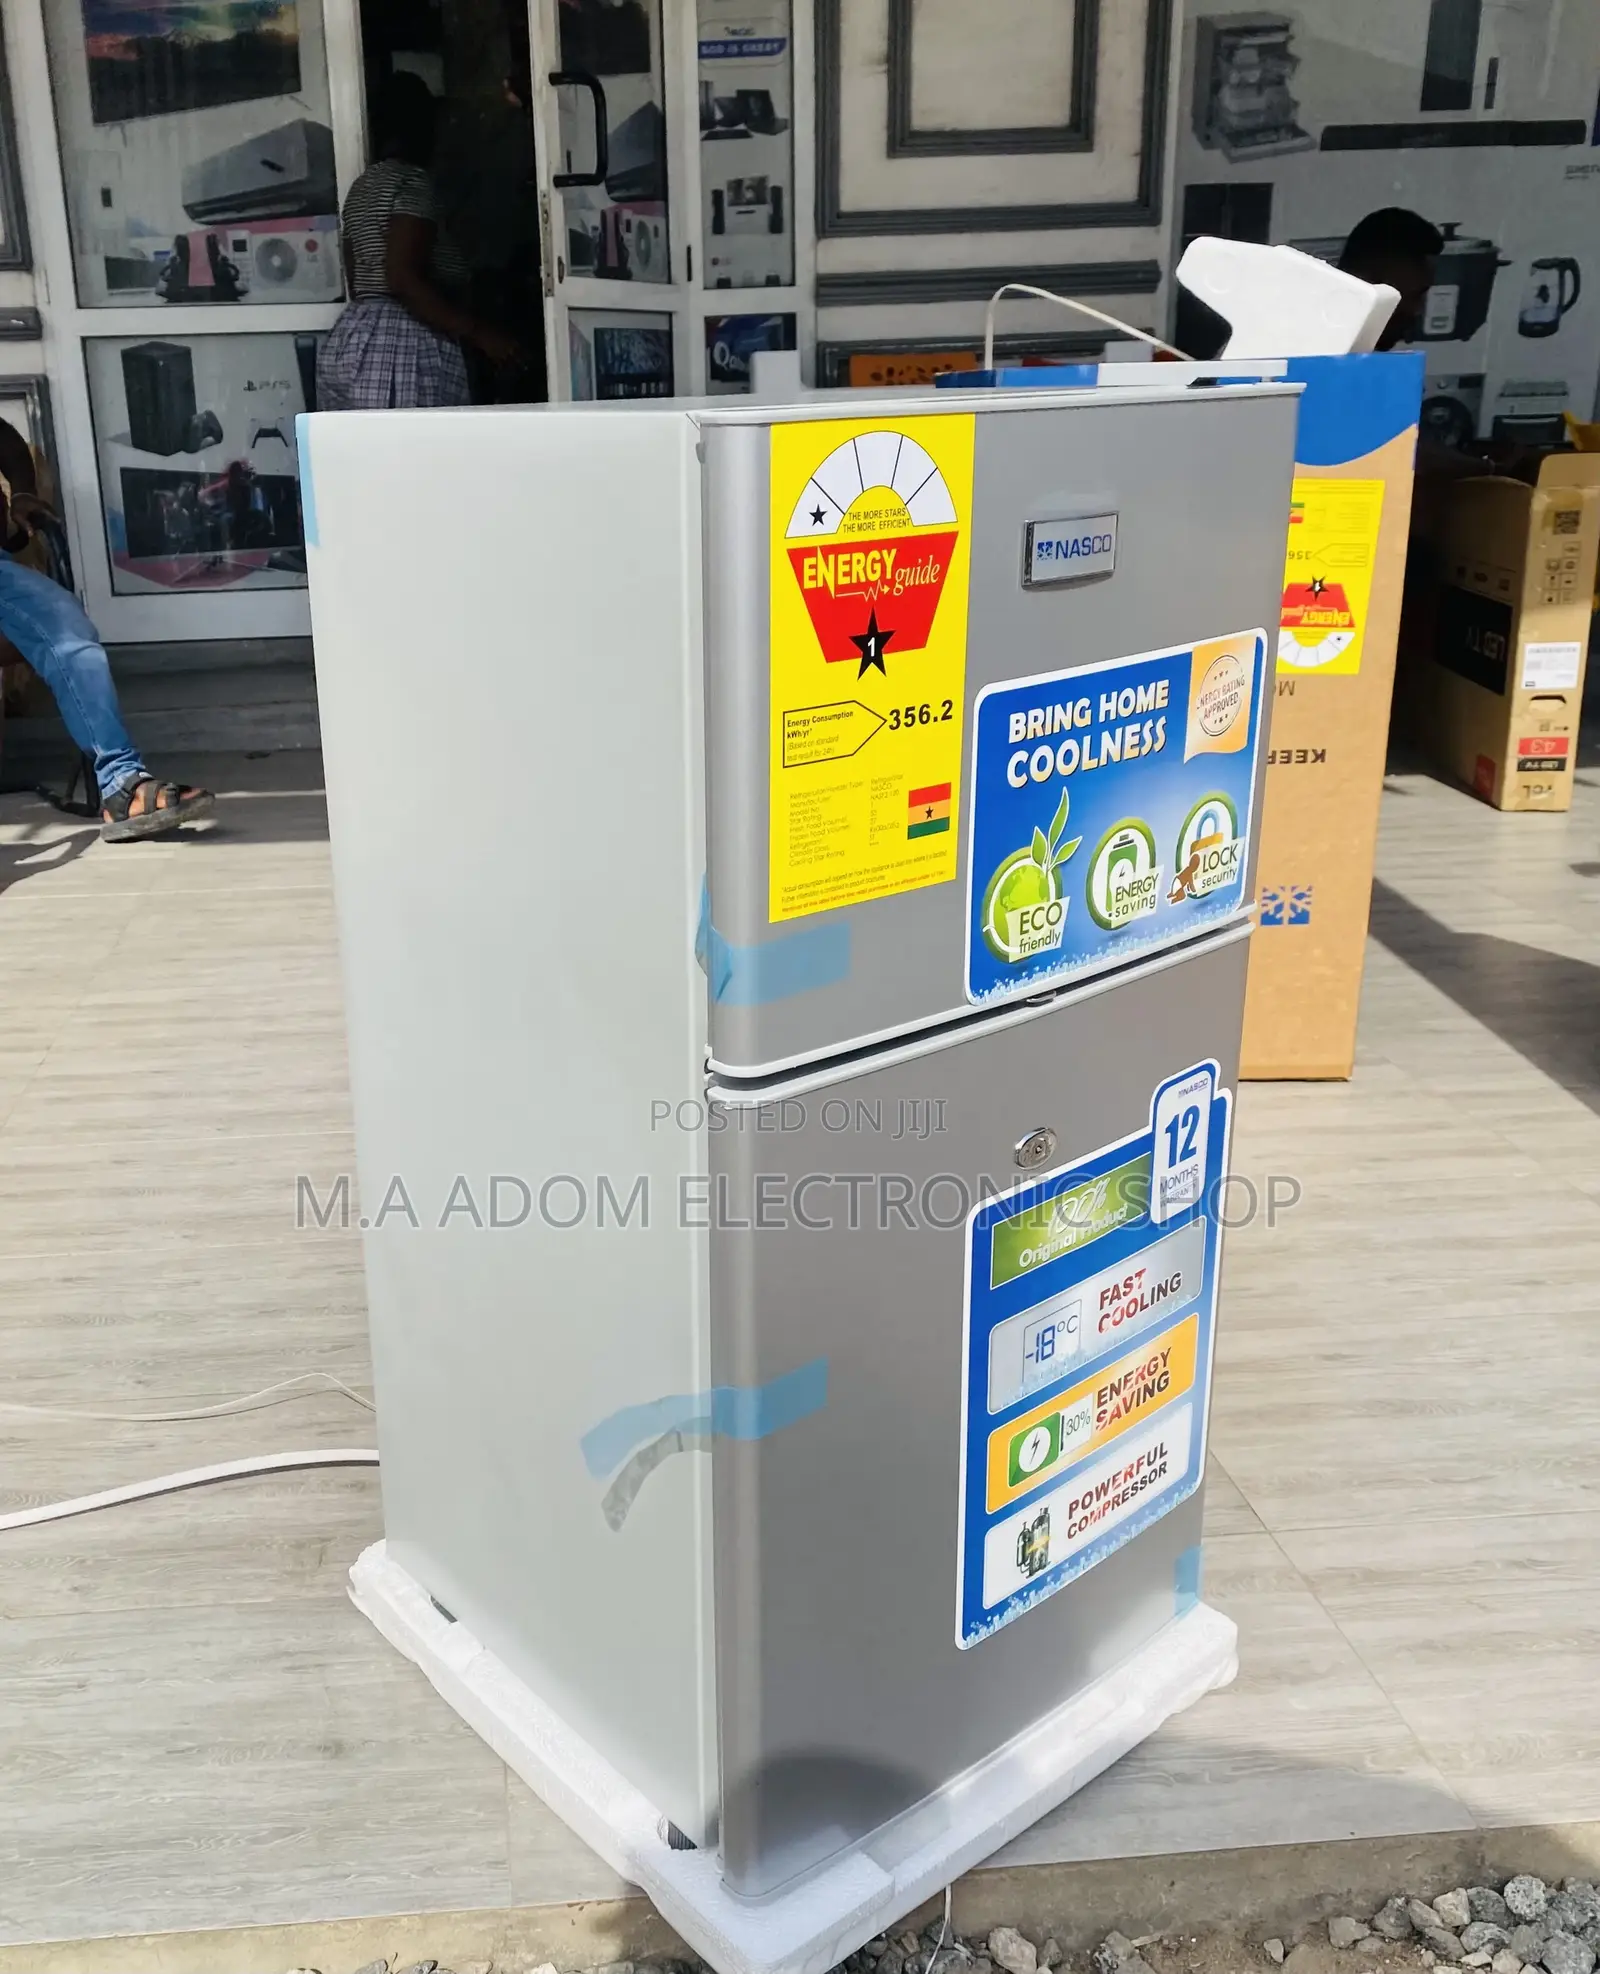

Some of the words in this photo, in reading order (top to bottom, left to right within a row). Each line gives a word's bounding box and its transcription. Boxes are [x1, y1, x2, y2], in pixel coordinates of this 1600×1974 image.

[843, 523, 857, 533] THE
[857, 521, 876, 532] MORE
[879, 517, 911, 530] EFFICIENT
[848, 511, 862, 521] THE
[863, 509, 884, 520] MORE
[884, 507, 906, 518] STARS
[1056, 534, 1112, 560] NASCO
[803, 546, 897, 600] ENERGY
[893, 555, 941, 597] guide
[867, 637, 876, 657] 1
[1197, 686, 1222, 711] NERGY
[1222, 674, 1246, 696] RATING
[1203, 691, 1239, 719] APPROVED
[787, 718, 811, 728] Energy
[812, 711, 854, 724] Consumption
[888, 699, 954, 731] 356.2
[1008, 696, 1092, 744] BRING
[1099, 679, 1170, 723] HOME
[1006, 715, 1167, 789] COOLNESS
[1268, 749, 1326, 764] KEEP
[1202, 843, 1239, 874] LOCK
[1115, 873, 1160, 903] ENERGY
[1201, 865, 1238, 889] security
[1019, 902, 1063, 936] ECO
[1115, 892, 1157, 918] saving
[1019, 930, 1061, 954] friendly
[1164, 1104, 1200, 1169] 12
[1160, 1163, 1199, 1196] MONTHS
[1019, 1230, 1077, 1268] Original
[1080, 1202, 1128, 1241] Product
[1098, 1272, 1182, 1334] COOLING
[1099, 1268, 1147, 1311] FAST
[1096, 1347, 1172, 1409] ENERGY
[1096, 1370, 1170, 1431] SAVING
[1066, 1408, 1091, 1436] 30%
[1068, 1442, 1168, 1520] POWERFUL
[1067, 1461, 1168, 1541] COMPRESSOR
